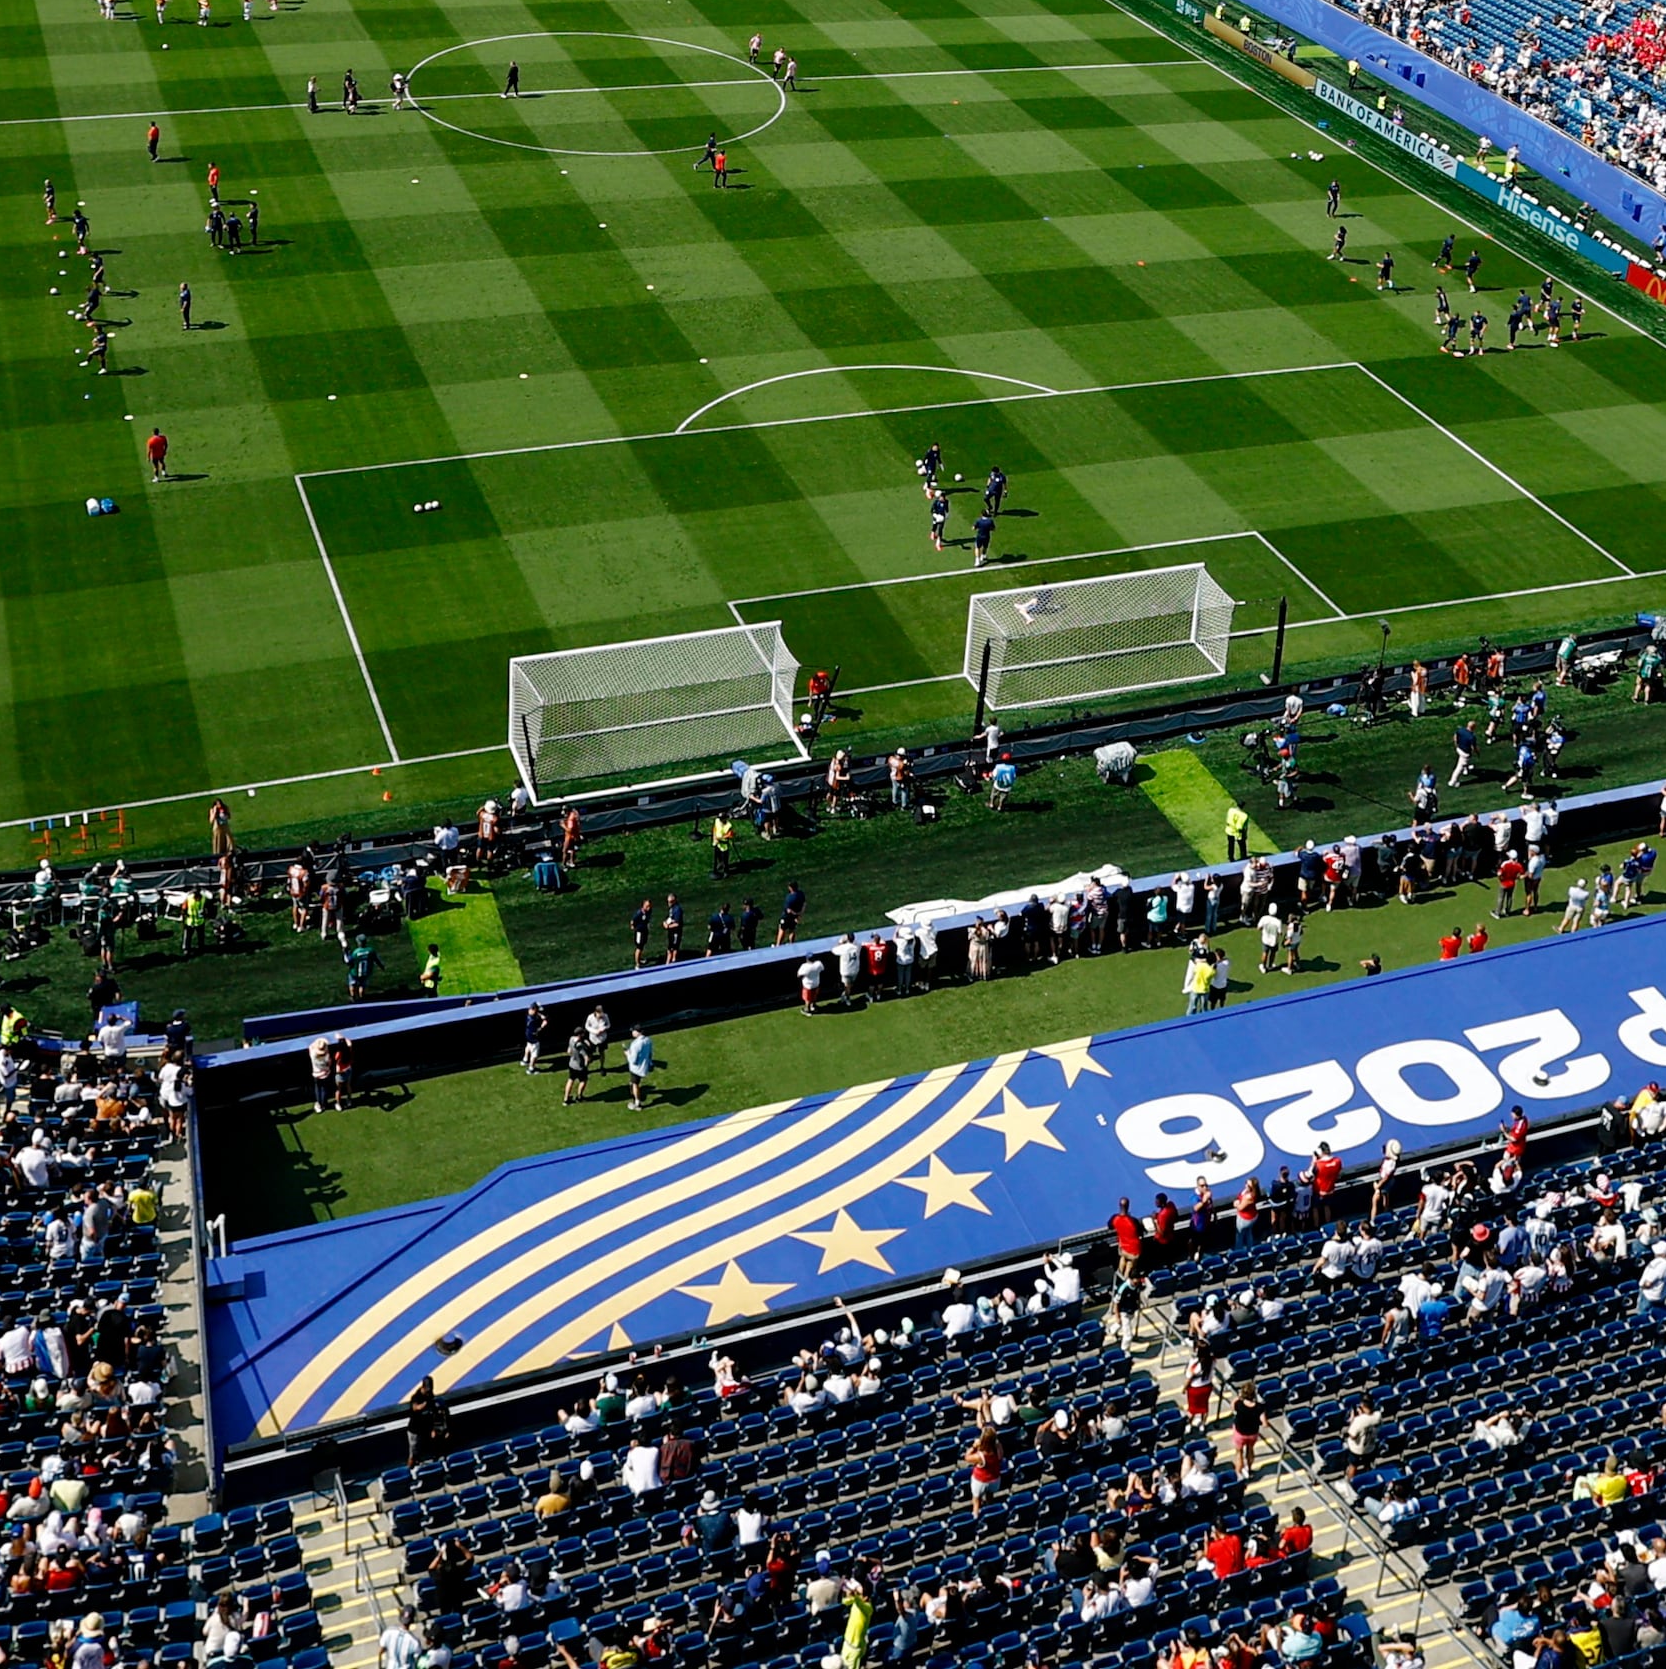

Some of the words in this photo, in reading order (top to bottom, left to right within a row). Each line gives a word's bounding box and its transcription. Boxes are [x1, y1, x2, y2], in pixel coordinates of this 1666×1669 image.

[1243, 39, 1273, 65] BOSTON
[1319, 83, 1353, 114] BANK
[1356, 106, 1372, 124] OF
[1374, 114, 1435, 163] AMERICA
[1497, 185, 1580, 252] Hisense
[1114, 1008, 1612, 1190] 2026
